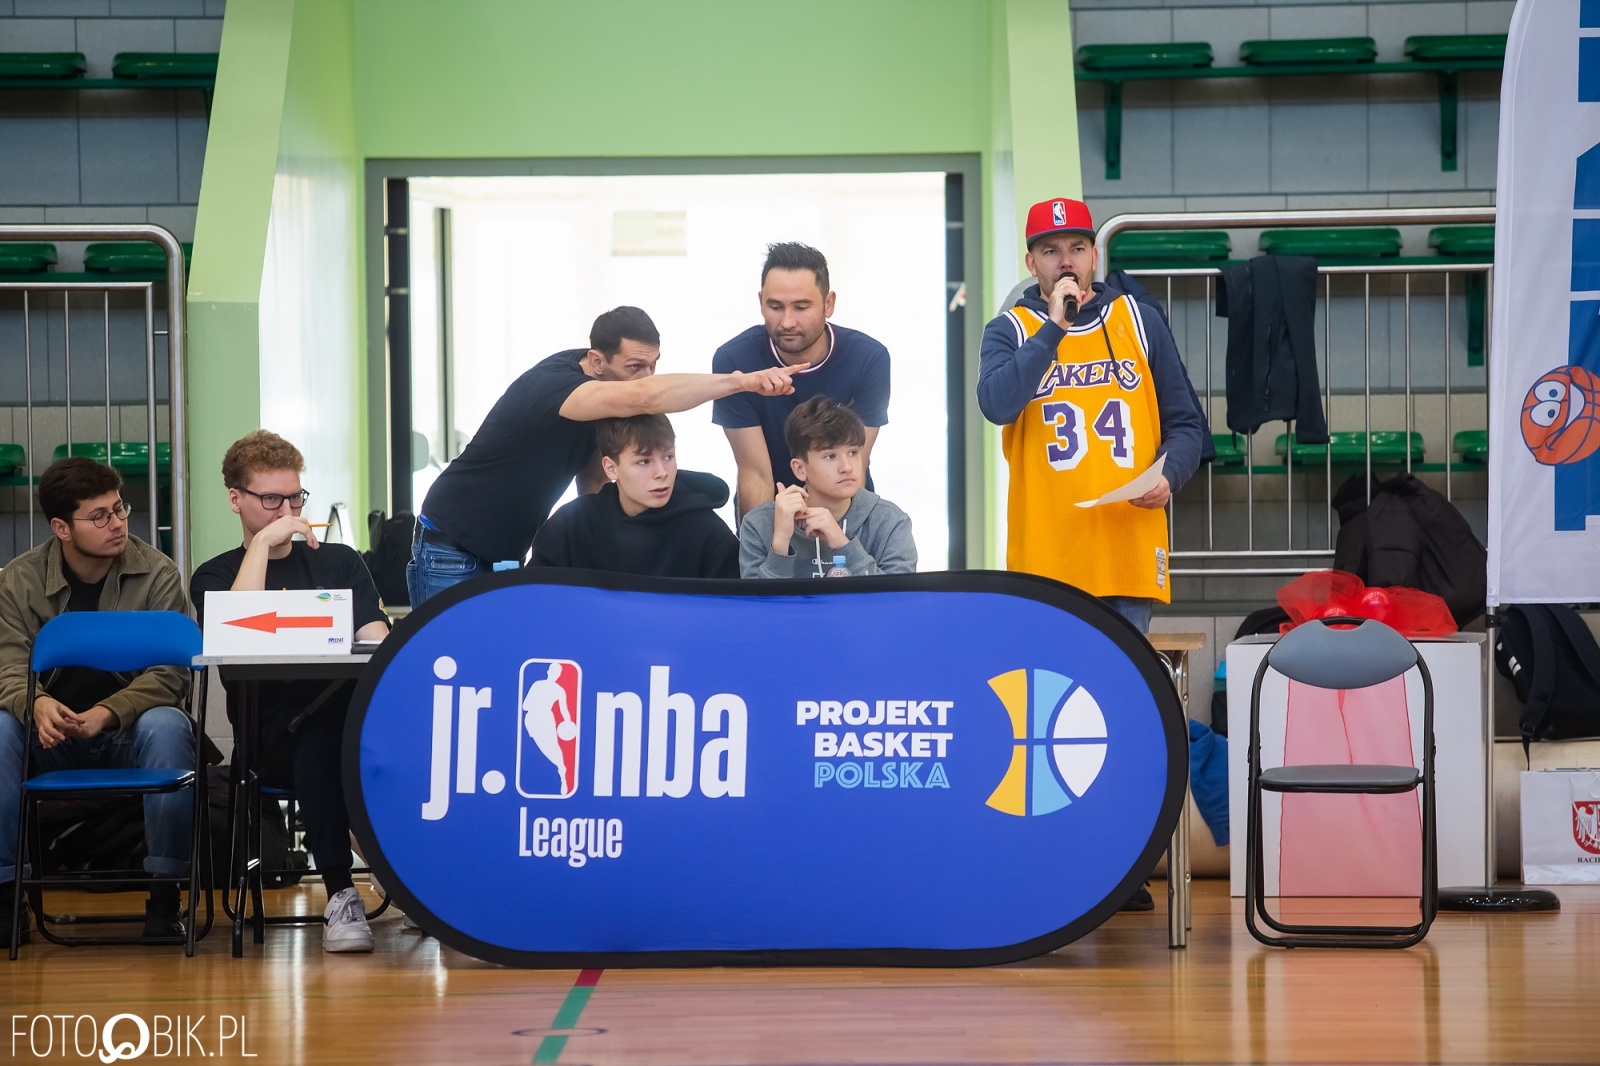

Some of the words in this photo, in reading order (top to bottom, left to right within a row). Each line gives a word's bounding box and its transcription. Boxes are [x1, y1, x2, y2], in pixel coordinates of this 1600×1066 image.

[1042, 398, 1135, 472] 34
[796, 700, 954, 726] PROJEKT
[421, 656, 506, 821] jr.
[593, 665, 748, 799] nba
[814, 732, 954, 758] BASKET
[814, 762, 950, 789] POLSKA
[519, 806, 623, 868] League
